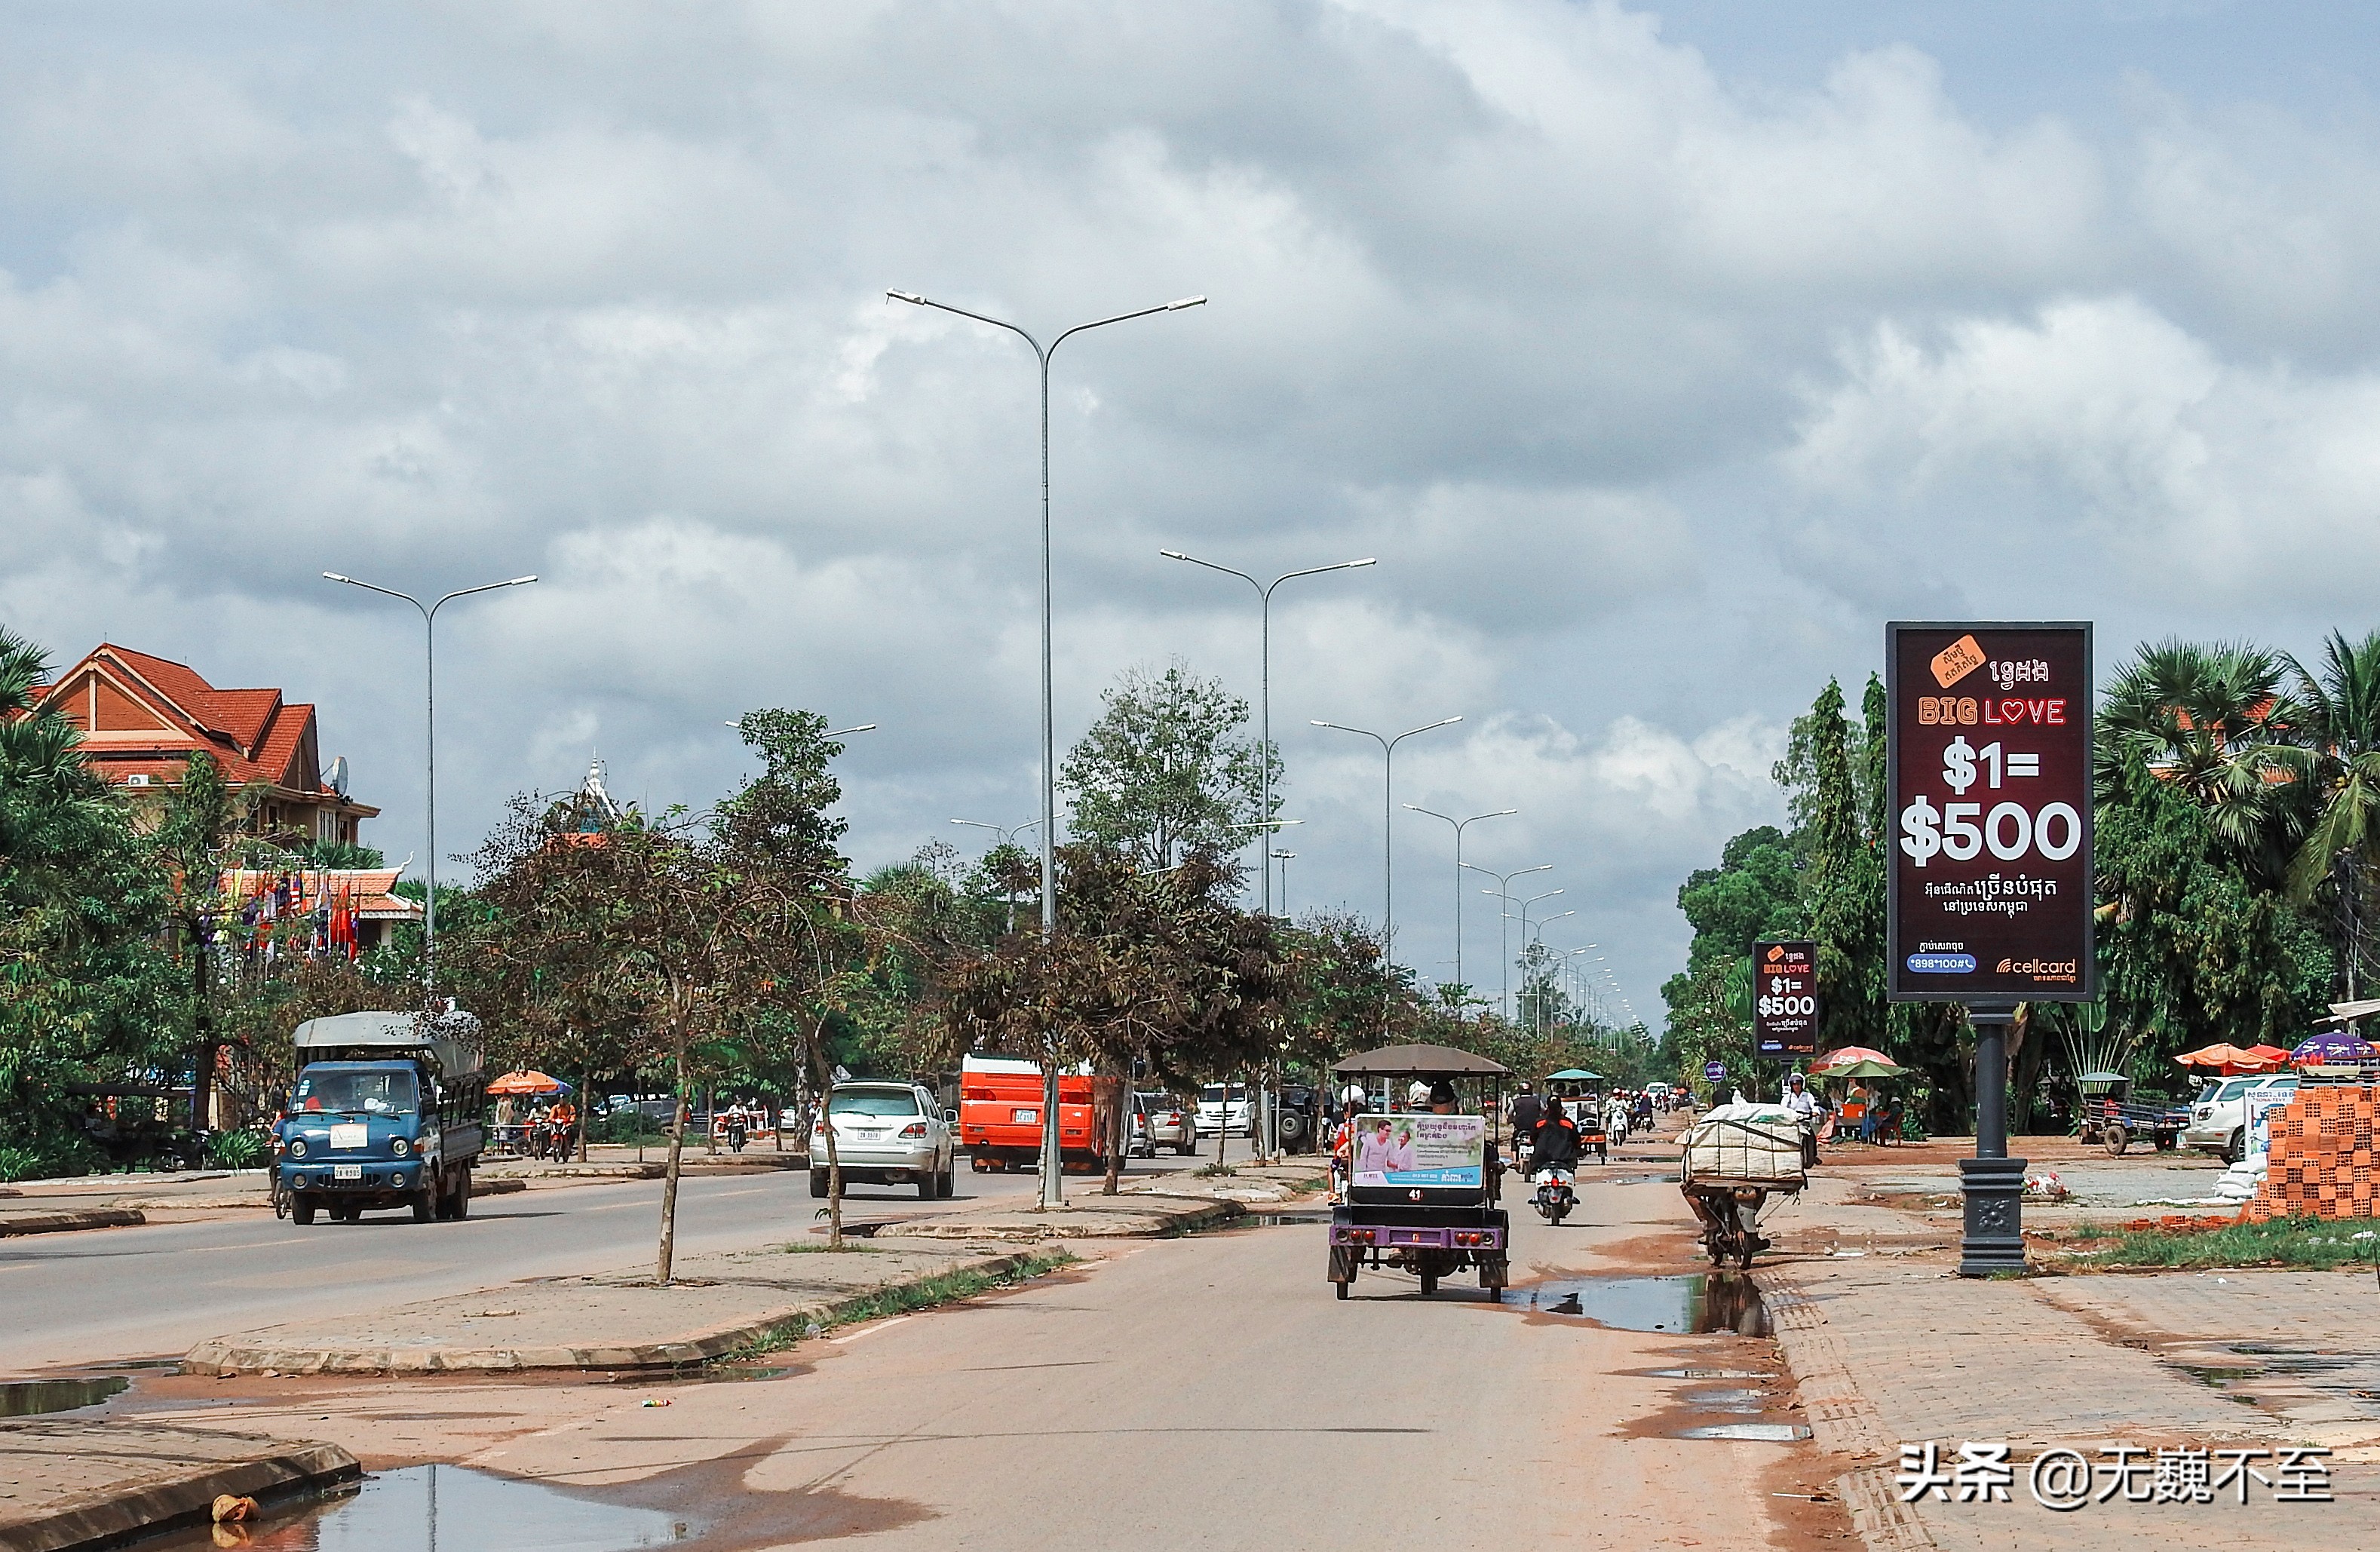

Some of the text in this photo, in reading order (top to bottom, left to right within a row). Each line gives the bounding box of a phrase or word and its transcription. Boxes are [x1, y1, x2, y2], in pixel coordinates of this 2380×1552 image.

[1989, 658, 2049, 691] ទ្វេដង
[1918, 697, 1978, 725] BIG
[1900, 795, 2082, 867] $500
[2012, 958, 2076, 974] cellcard
[1771, 976, 1802, 995] $1=
[1758, 995, 1815, 1018] $500
[1409, 1189, 1422, 1201] 41
